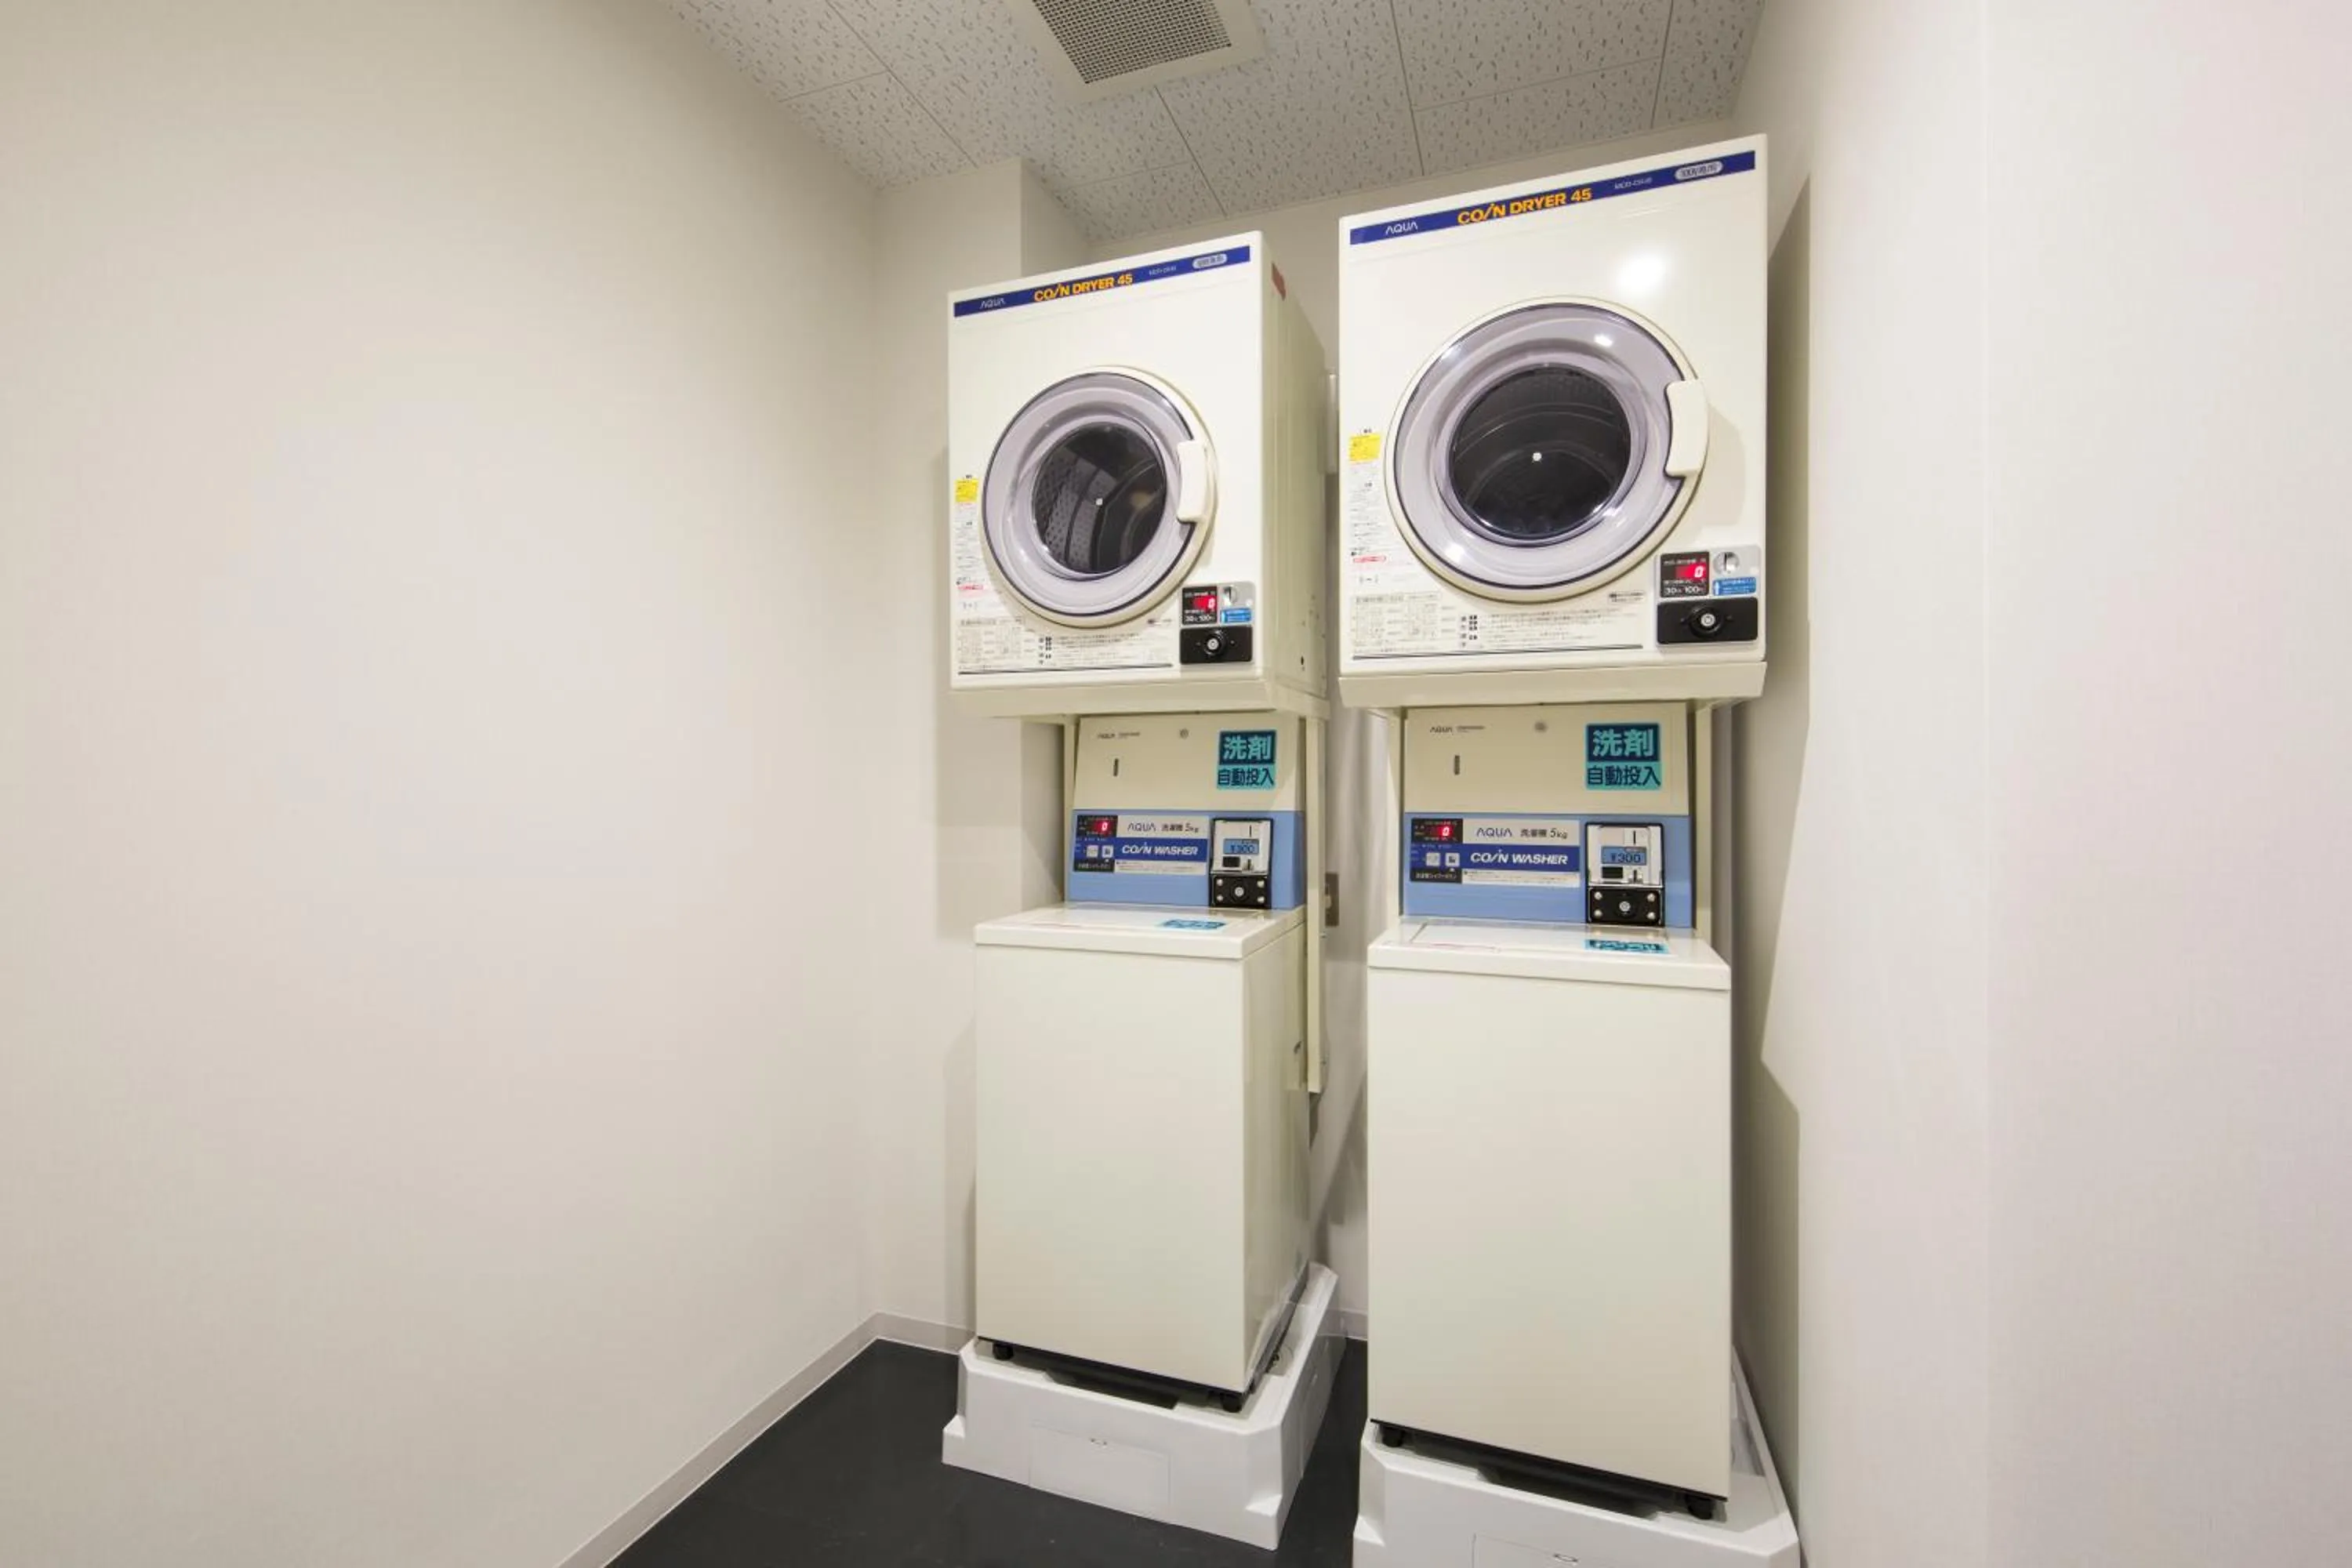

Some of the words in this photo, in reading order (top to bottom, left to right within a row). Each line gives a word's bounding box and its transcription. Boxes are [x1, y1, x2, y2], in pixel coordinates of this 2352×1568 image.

[1385, 221, 1417, 234] AQUA
[1509, 193, 1566, 216] DRYER
[1570, 188, 1592, 203] 45
[979, 297, 1005, 309] AQUA
[1073, 277, 1113, 296] DRYER
[1117, 274, 1133, 285] 45
[1694, 565, 1704, 579] 0
[1224, 736, 1270, 760] 洗剤
[1592, 728, 1653, 758] 洗剤
[1218, 768, 1274, 786] 自動投入
[1587, 765, 1661, 786] 自動投入
[1127, 822, 1156, 832] AQUA
[1476, 827, 1512, 838] AQUA
[1153, 846, 1199, 856] WASHER
[1512, 853, 1568, 865] WASHER
